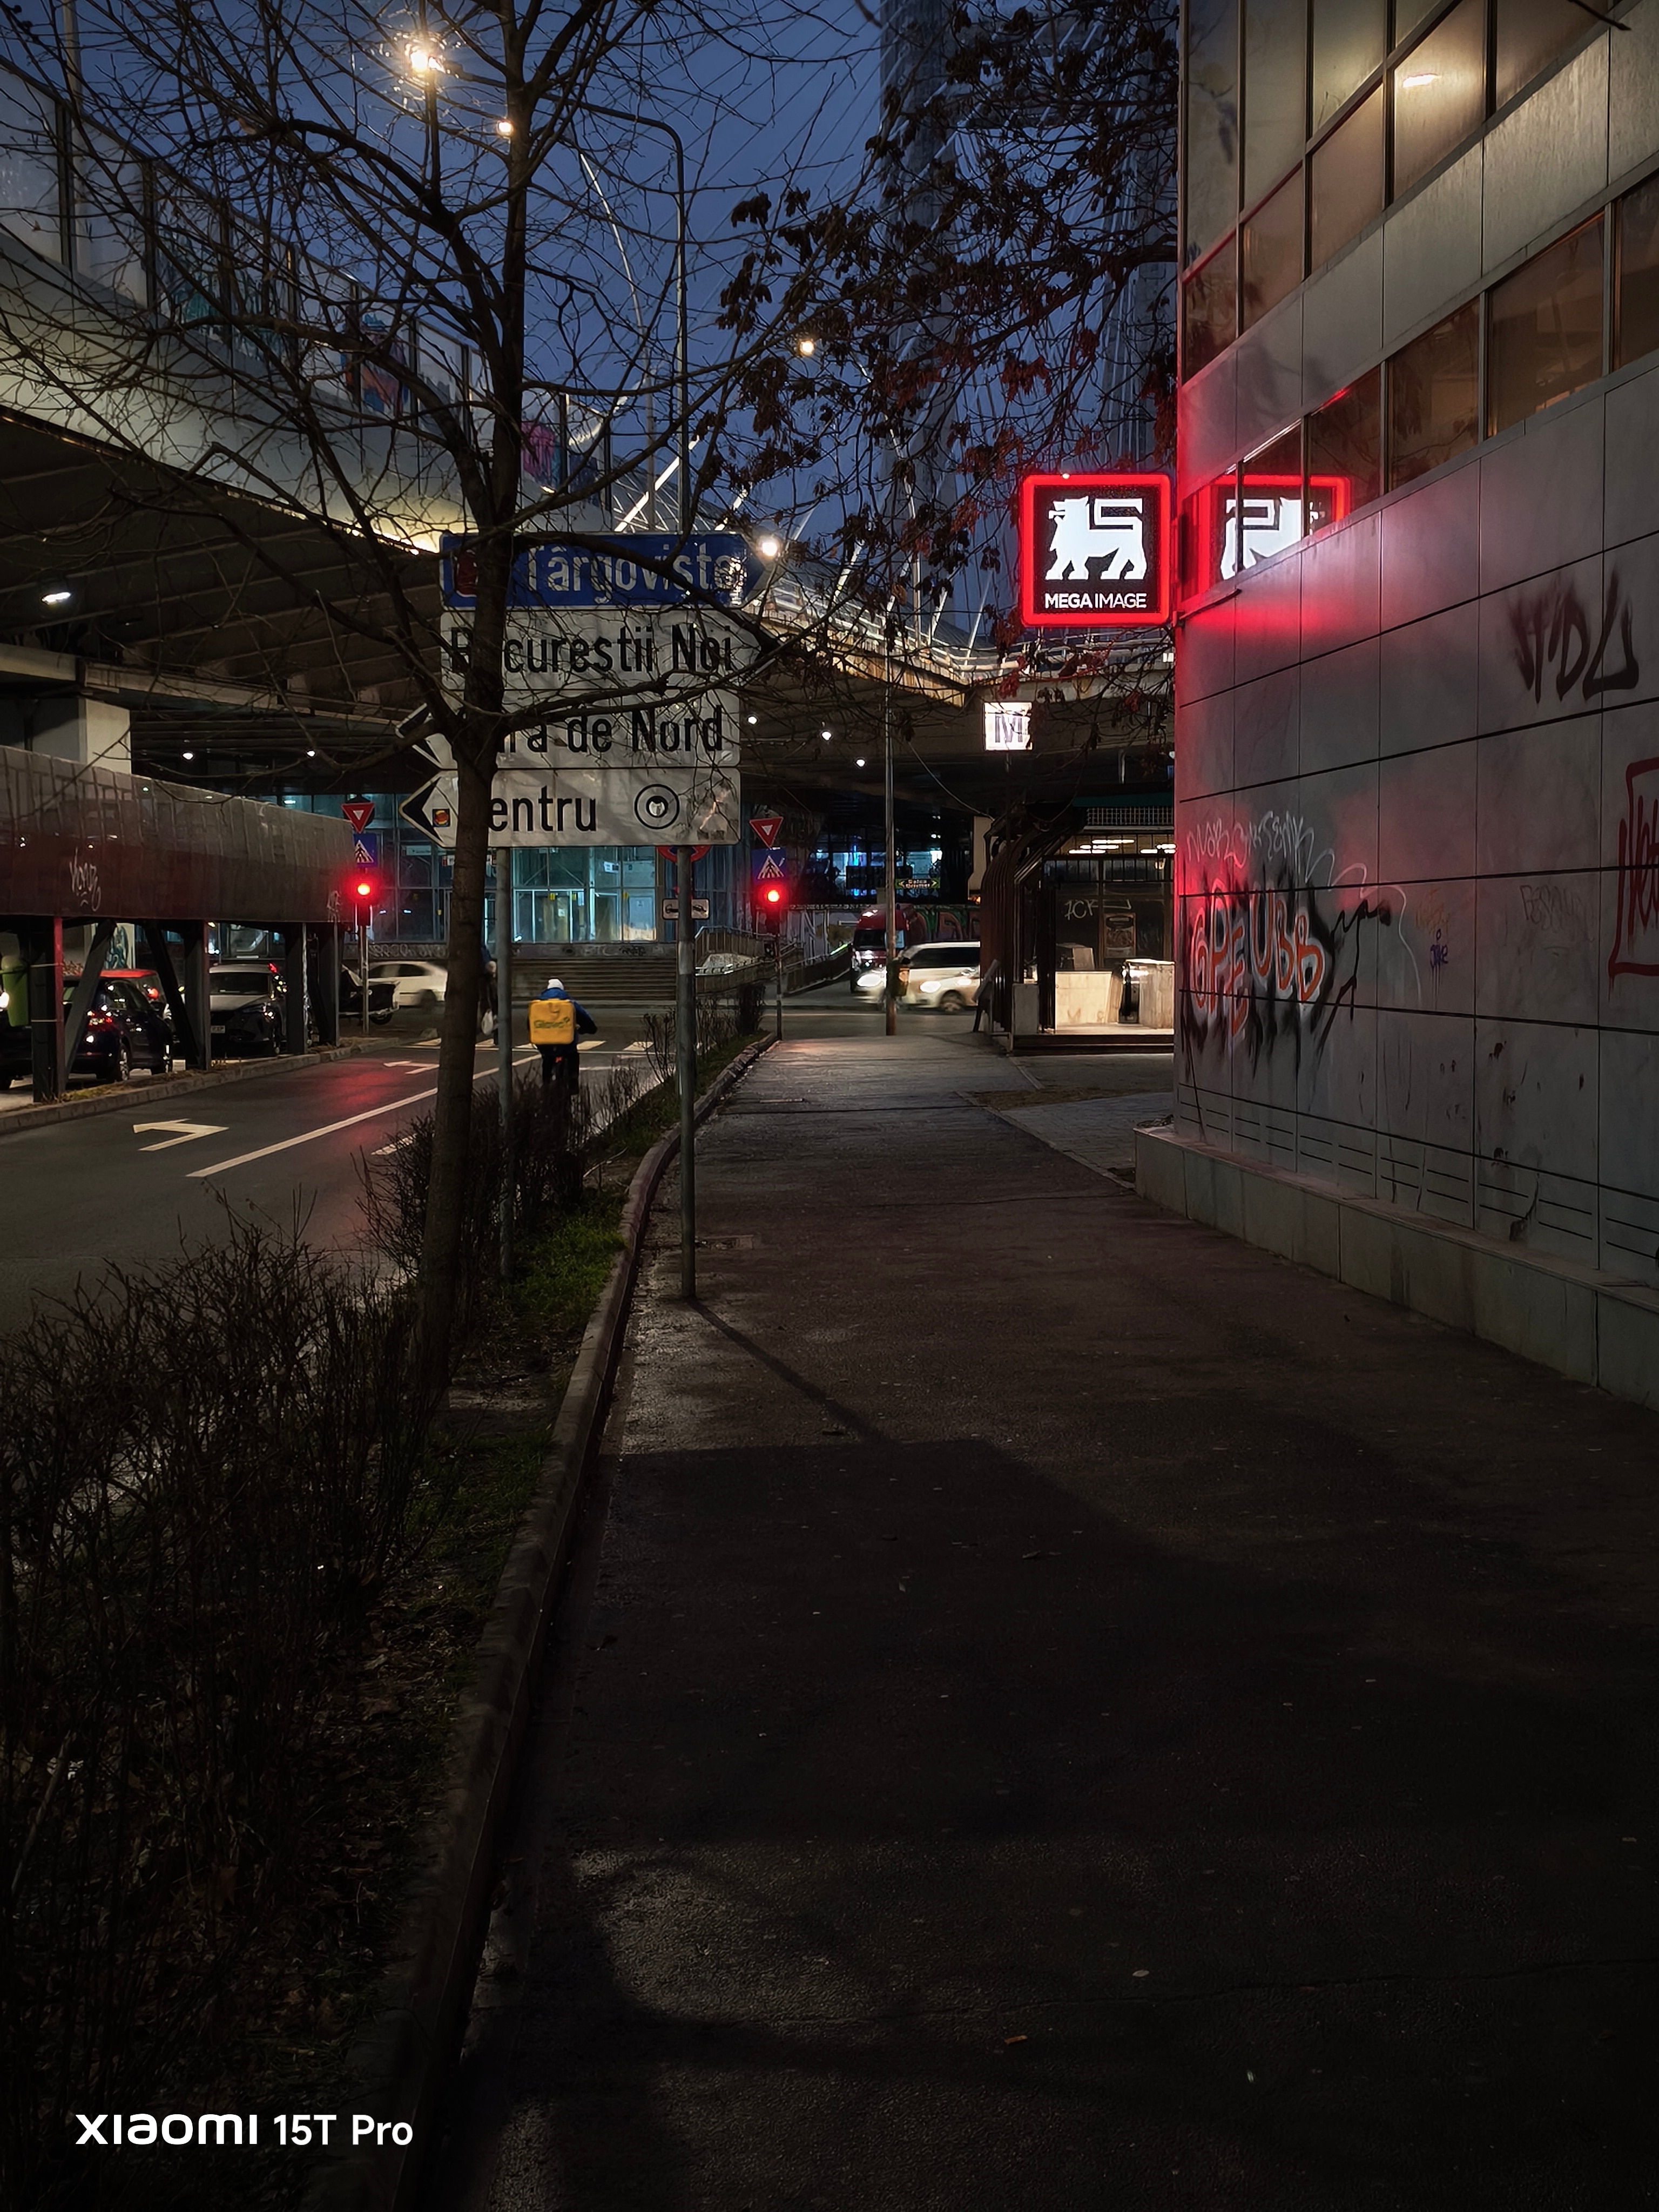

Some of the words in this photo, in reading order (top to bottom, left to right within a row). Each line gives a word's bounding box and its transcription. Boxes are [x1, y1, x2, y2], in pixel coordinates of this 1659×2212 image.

[1045, 593, 1093, 608] MEGA
[1095, 593, 1147, 608] IMAGE
[450, 626, 653, 673] Bcurestii
[672, 623, 731, 671] Noi
[567, 708, 612, 753] de
[632, 705, 722, 752] Nord
[488, 785, 597, 832] entru
